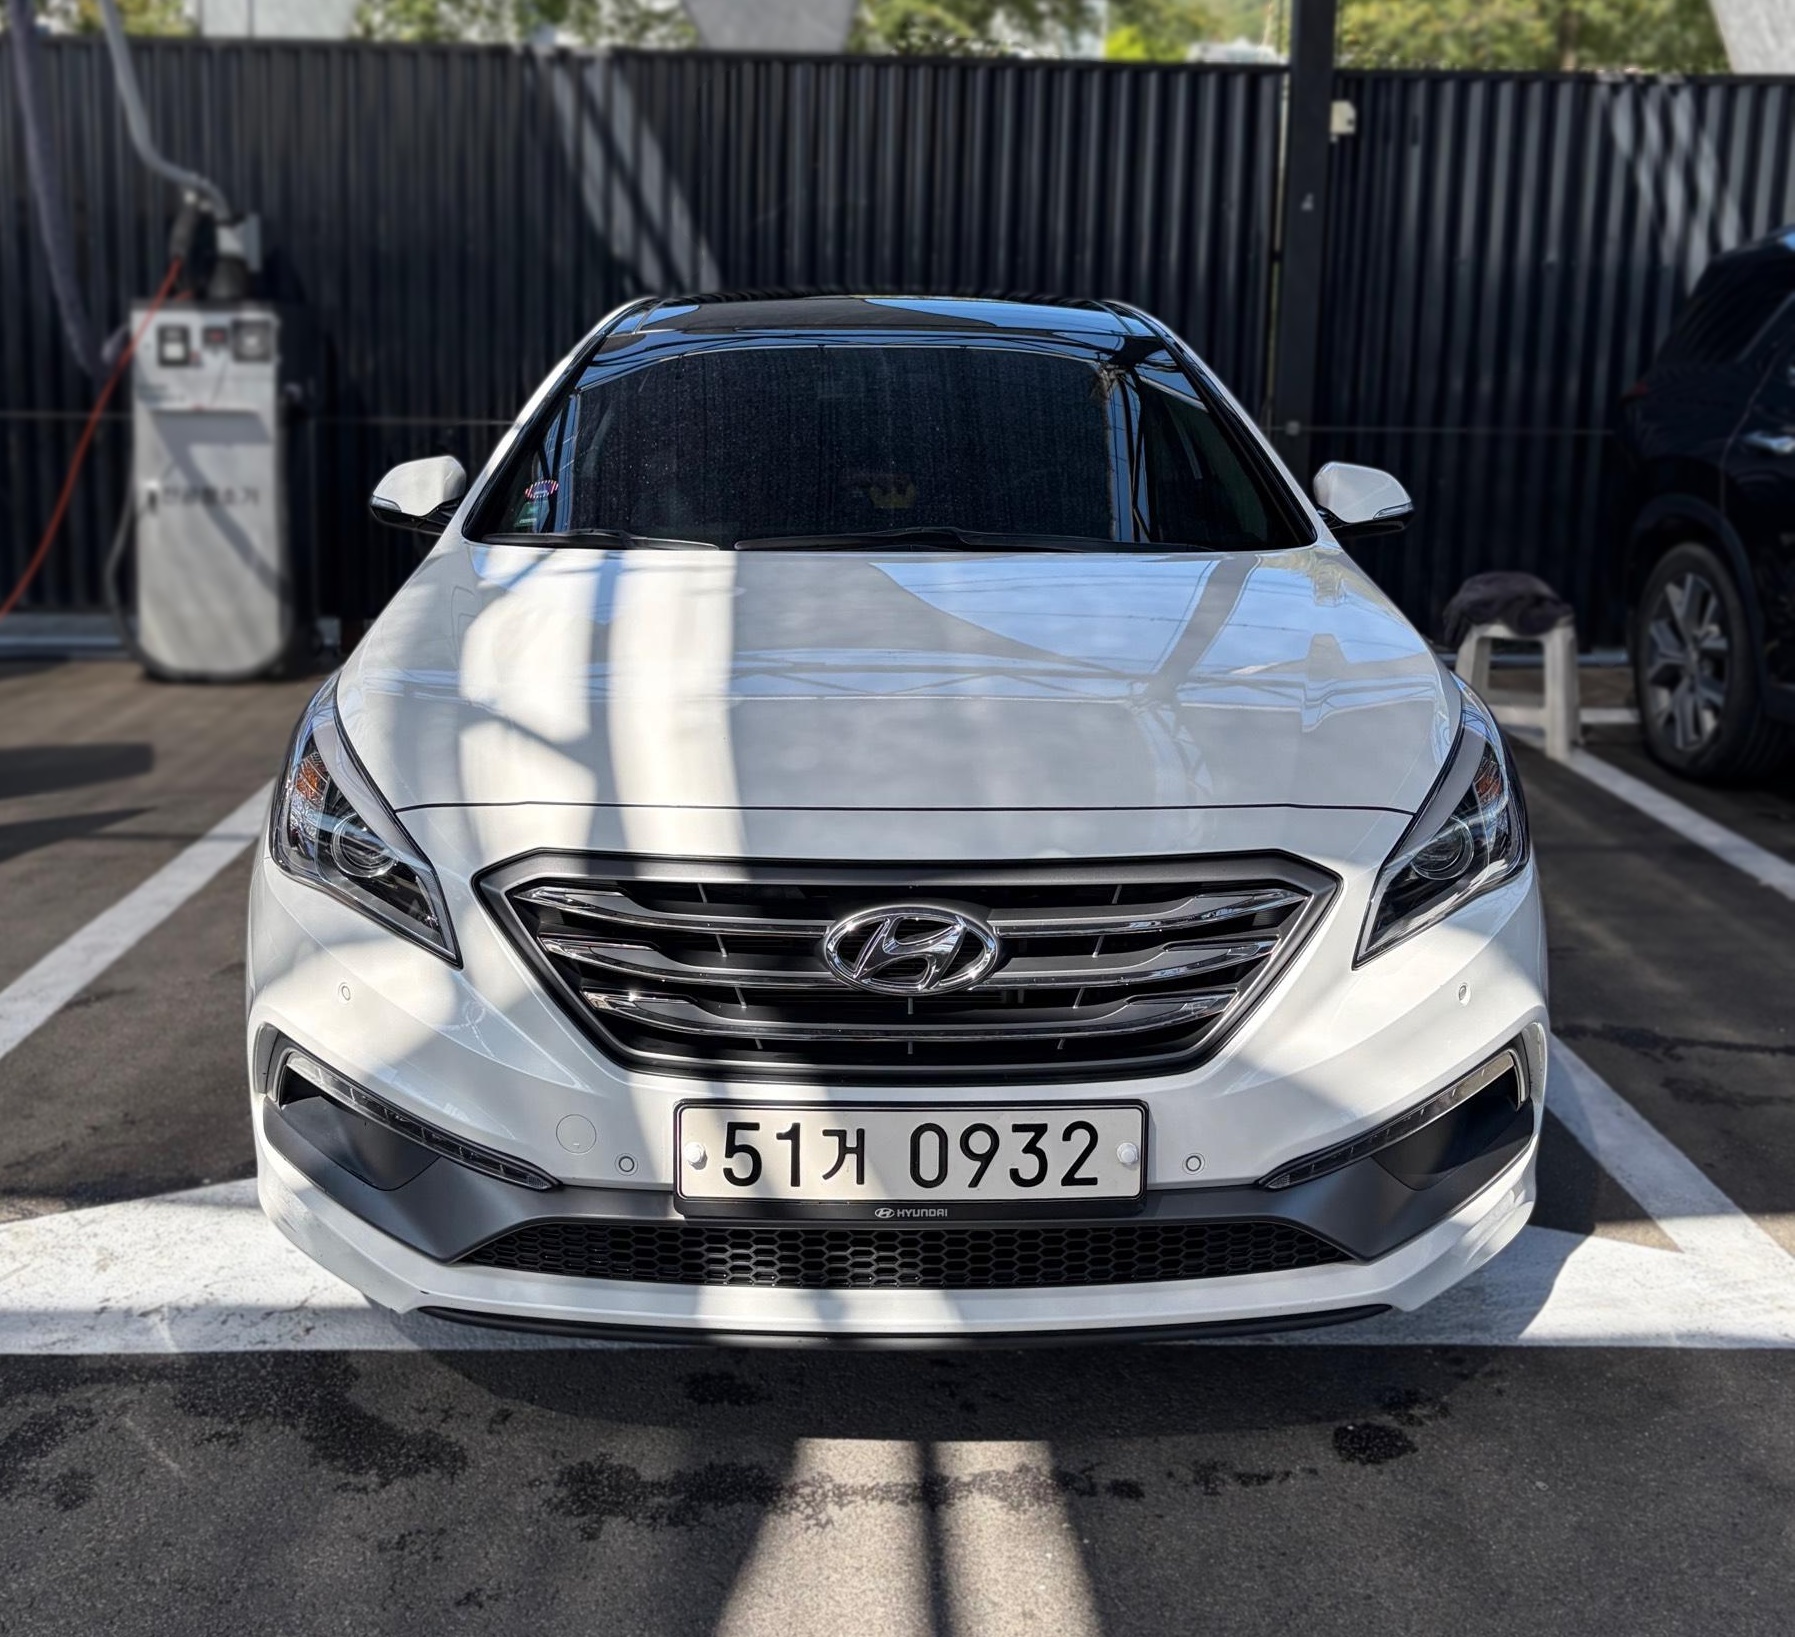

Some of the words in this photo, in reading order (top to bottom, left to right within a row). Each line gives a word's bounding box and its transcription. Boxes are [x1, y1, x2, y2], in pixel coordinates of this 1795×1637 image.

[722, 1121, 865, 1187] 51거
[909, 1120, 1099, 1189] 0932
[896, 1208, 949, 1217] HYUNDAI
